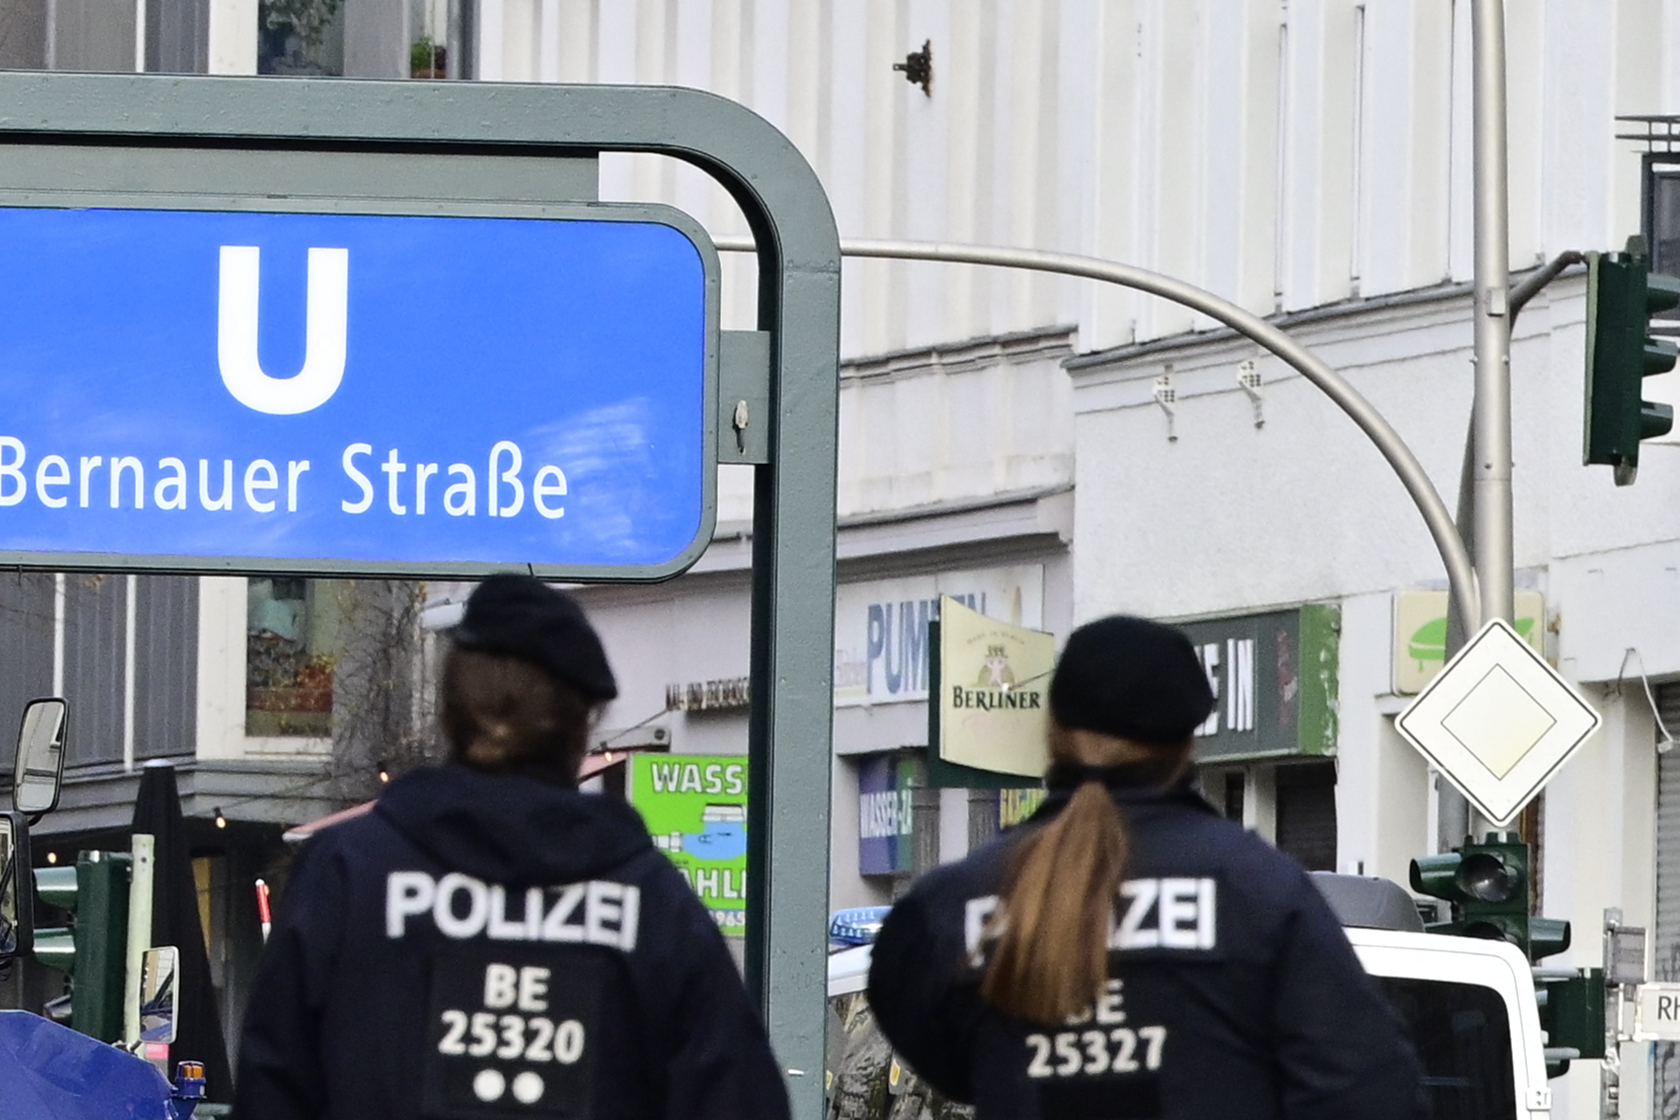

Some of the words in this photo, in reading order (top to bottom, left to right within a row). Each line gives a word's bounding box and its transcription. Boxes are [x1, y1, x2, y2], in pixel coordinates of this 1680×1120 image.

[218, 245, 348, 415] U
[341, 440, 568, 519] Straße
[952, 686, 1041, 711] BERLINER
[1227, 638, 1254, 732] IN
[386, 870, 641, 952] POLIZEI
[484, 963, 552, 1013] BE
[438, 1009, 585, 1065] 25320
[1026, 1025, 1167, 1078] 25327
